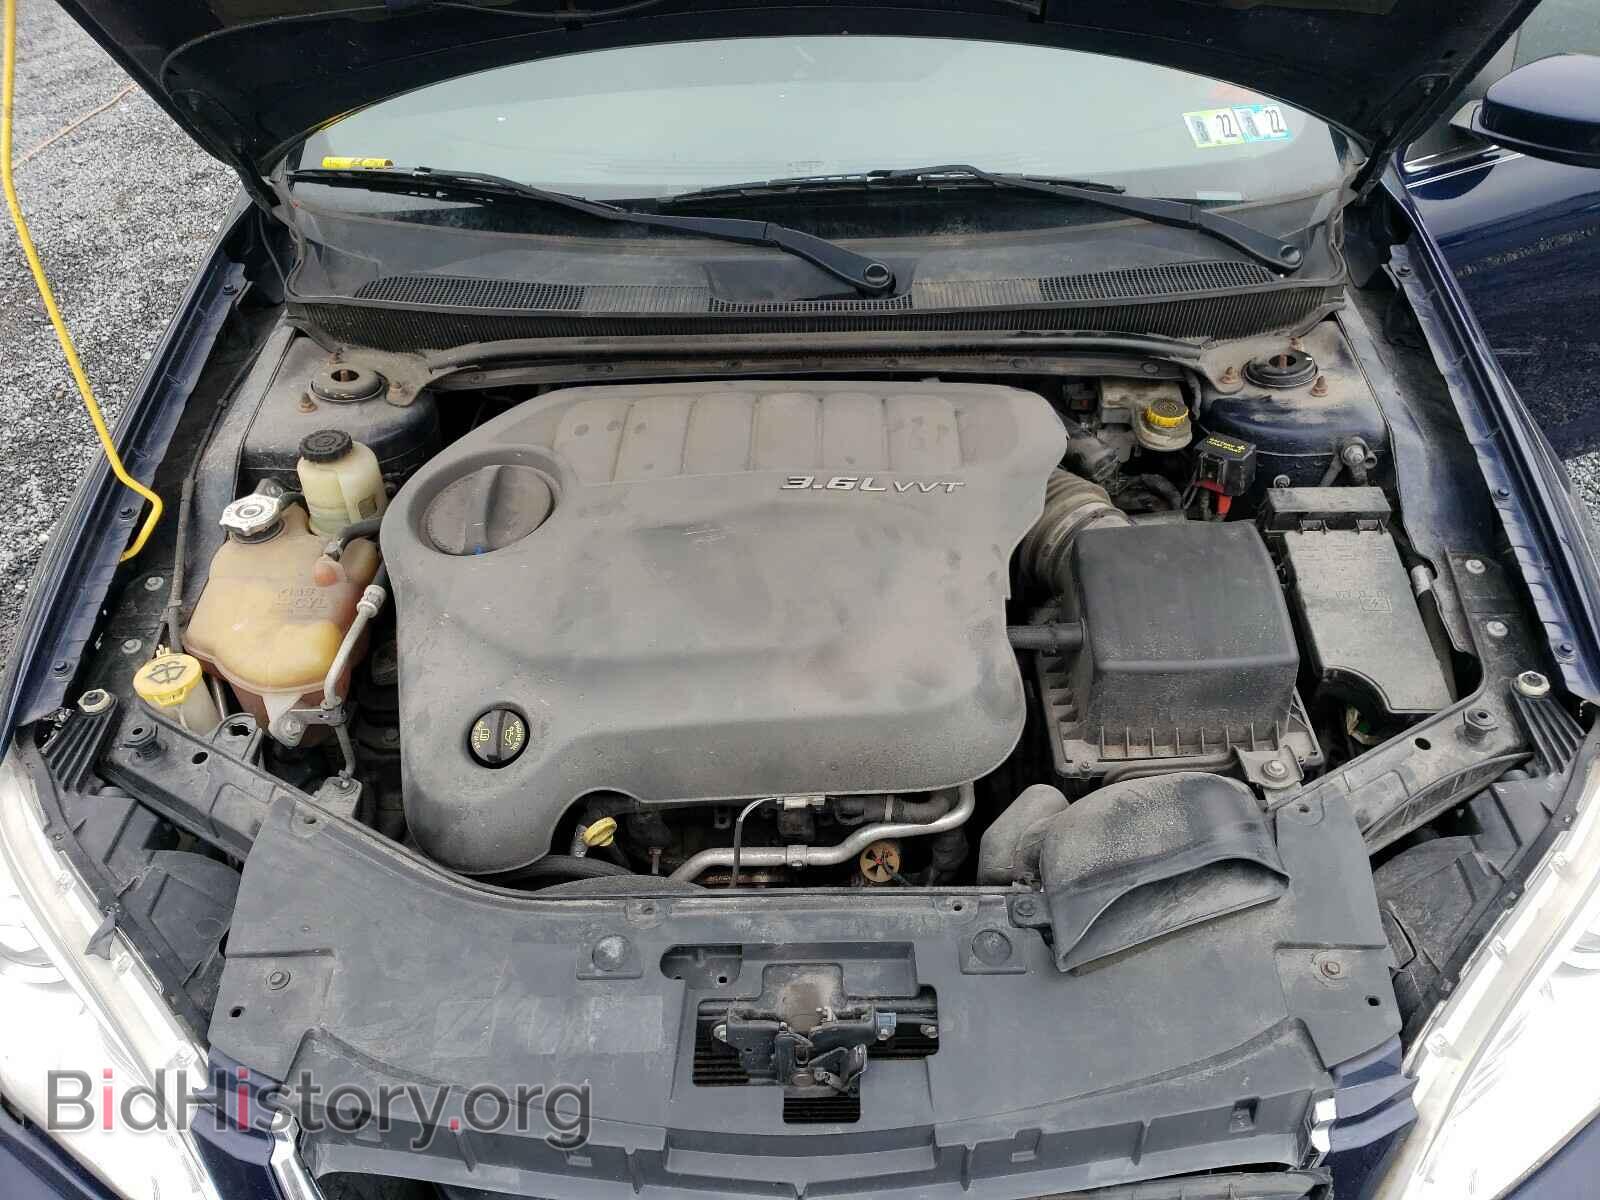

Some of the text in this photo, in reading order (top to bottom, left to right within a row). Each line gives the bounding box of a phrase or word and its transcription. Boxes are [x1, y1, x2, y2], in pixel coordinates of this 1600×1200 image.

[1216, 114, 1237, 138] 22
[1265, 109, 1285, 133] 22
[780, 475, 966, 494] 3.6L VVT
